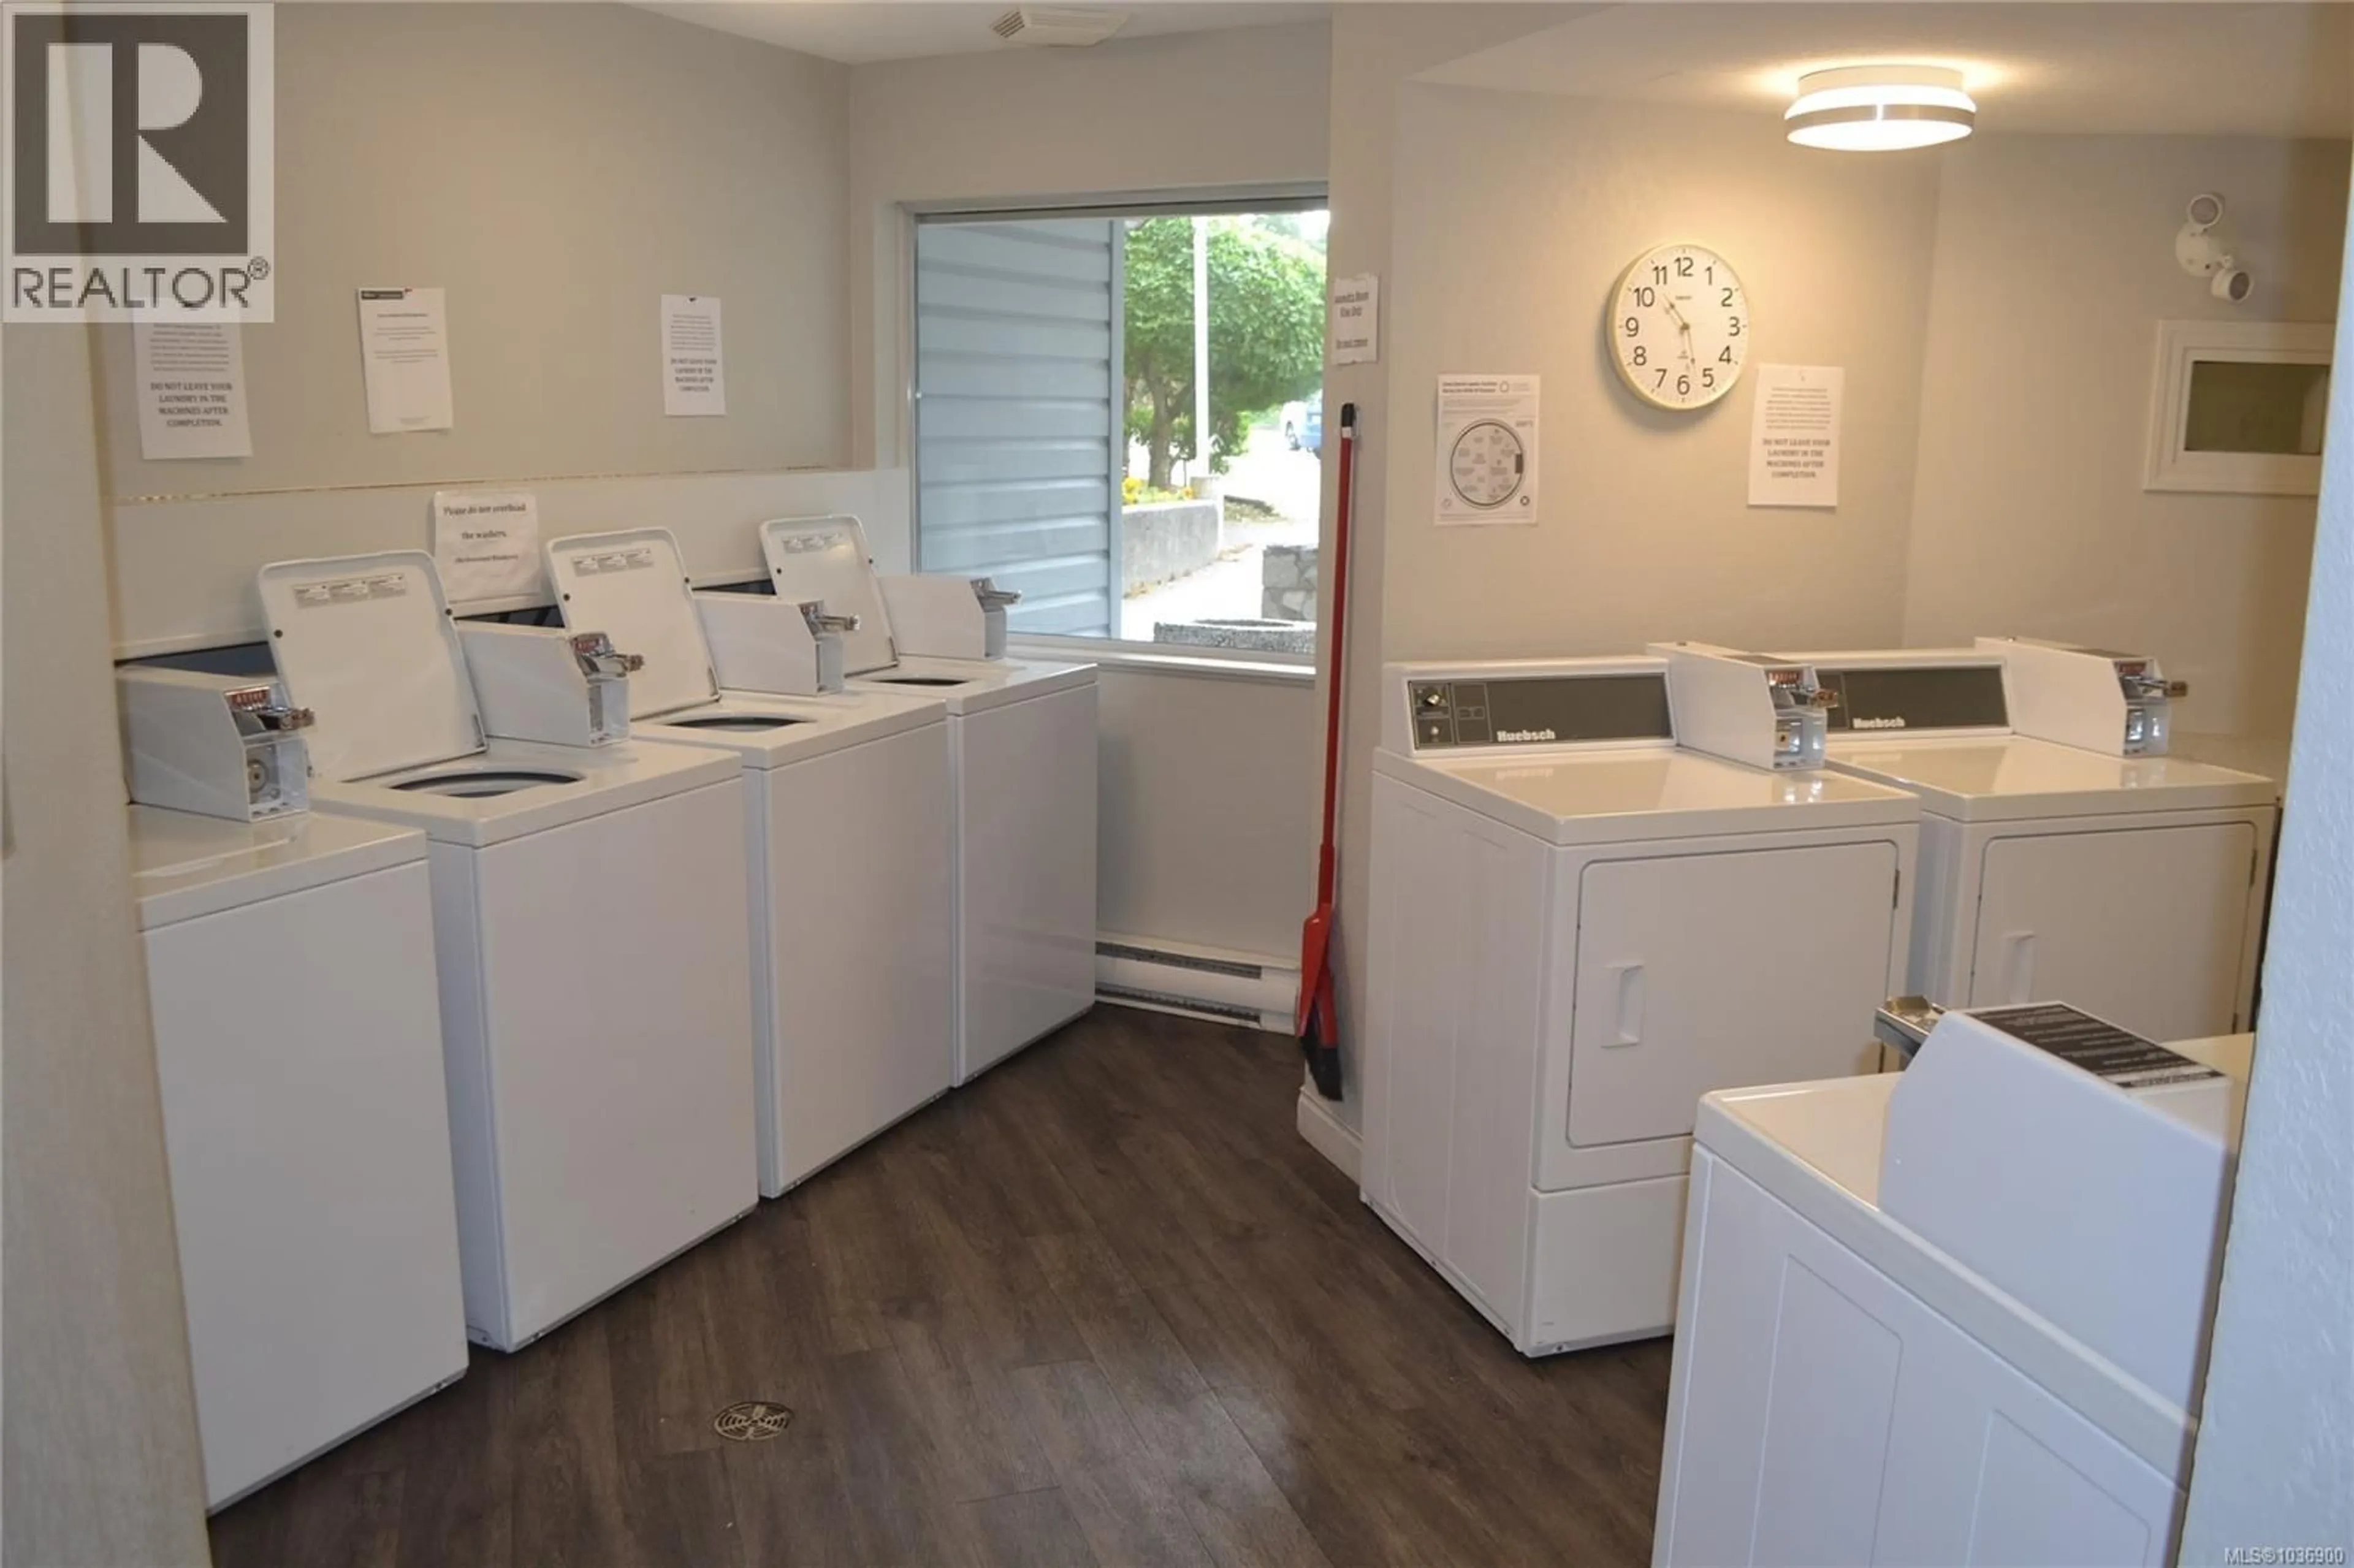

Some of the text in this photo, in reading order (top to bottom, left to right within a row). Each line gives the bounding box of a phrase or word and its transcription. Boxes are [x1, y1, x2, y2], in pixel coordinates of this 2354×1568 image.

[1653, 265, 1668, 285] 11
[1674, 256, 1694, 277] 12
[1705, 265, 1713, 286] 1
[1633, 286, 1655, 308] 10
[1721, 287, 1734, 307] 2
[1625, 316, 1639, 338] 9
[1729, 316, 1741, 337] 3
[1633, 345, 1647, 367] 8
[1718, 344, 1732, 365] 4
[1655, 368, 1668, 389] 7
[1677, 375, 1691, 395] 6
[1702, 368, 1715, 388] 5
[1496, 728, 1556, 742] Huebsch
